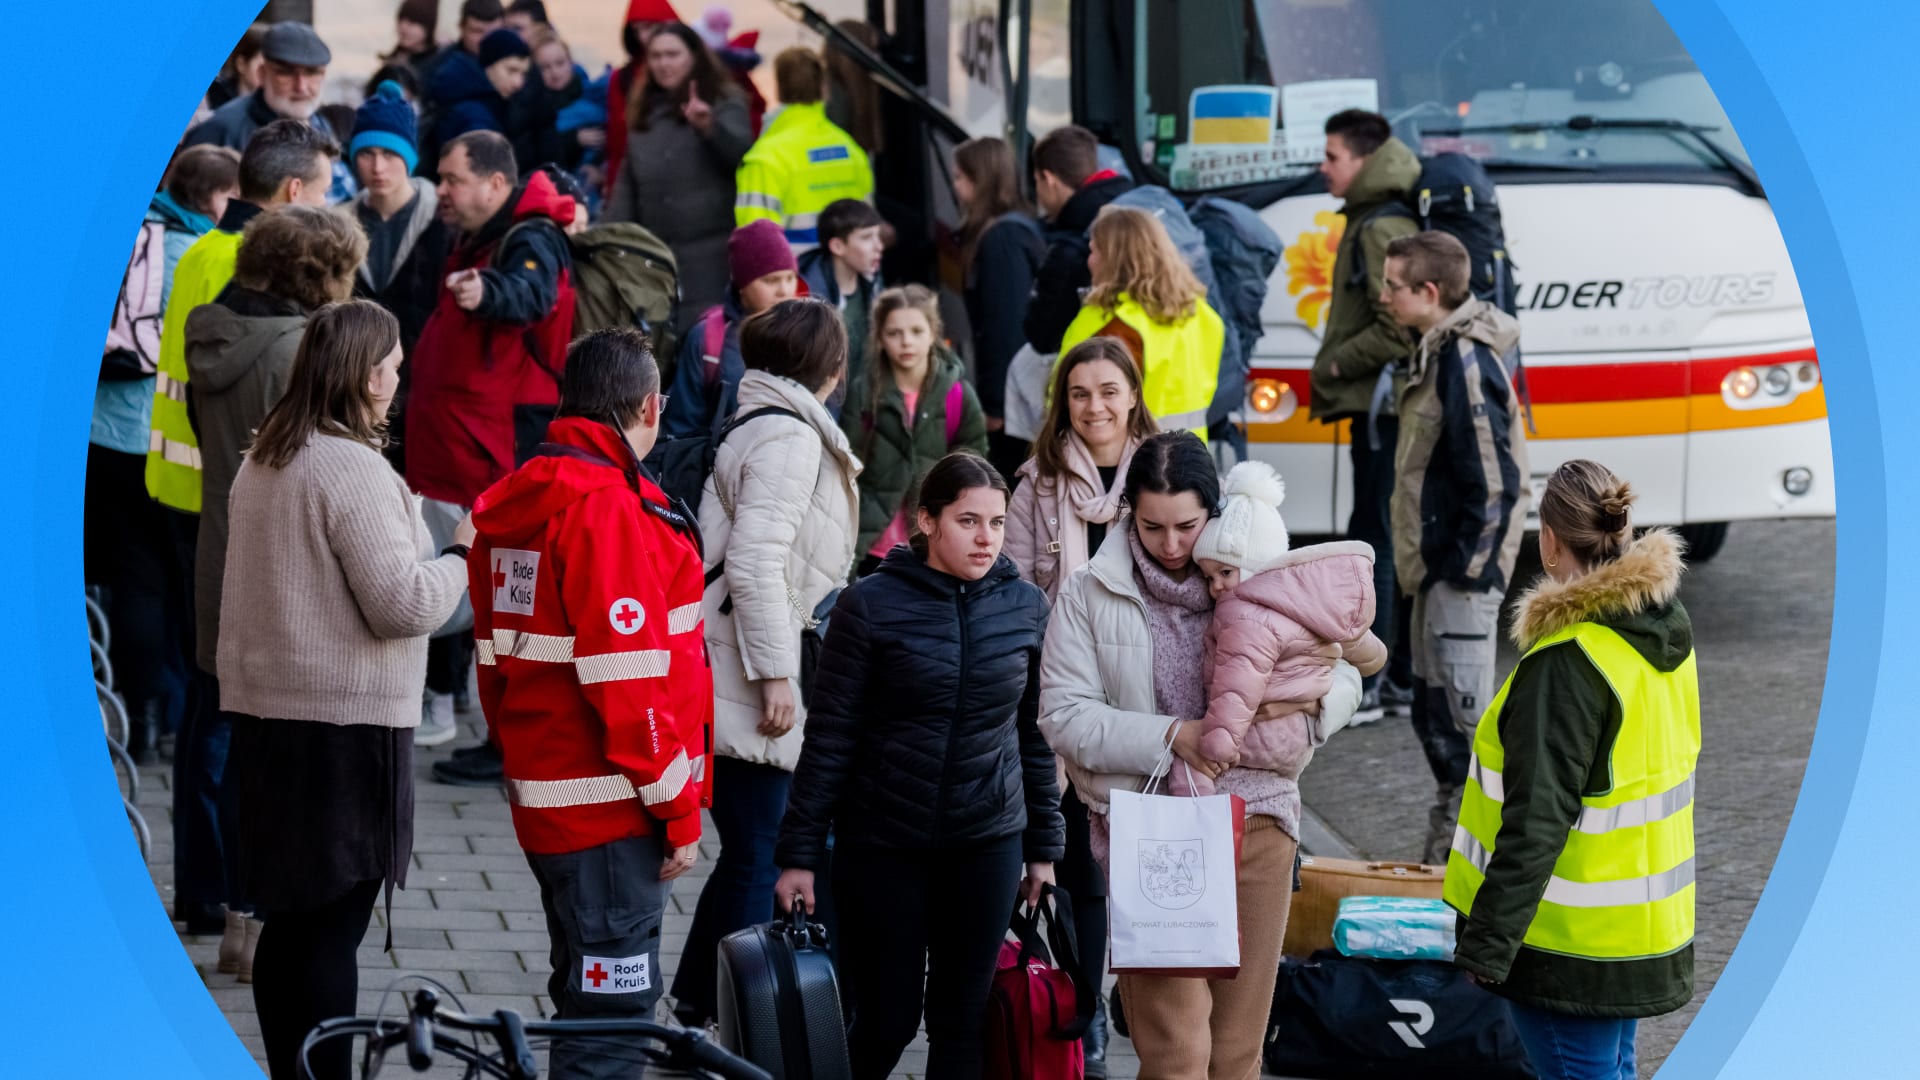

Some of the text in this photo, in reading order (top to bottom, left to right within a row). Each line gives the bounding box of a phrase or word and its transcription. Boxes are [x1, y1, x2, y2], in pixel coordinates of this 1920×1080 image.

[1628, 272, 1777, 309] TOURS
[513, 561, 534, 580] Rode
[646, 708, 660, 754] Rode Kruis
[1131, 921, 1161, 929] POWIAT
[614, 963, 645, 975] Rode
[614, 976, 646, 989] Kruis
